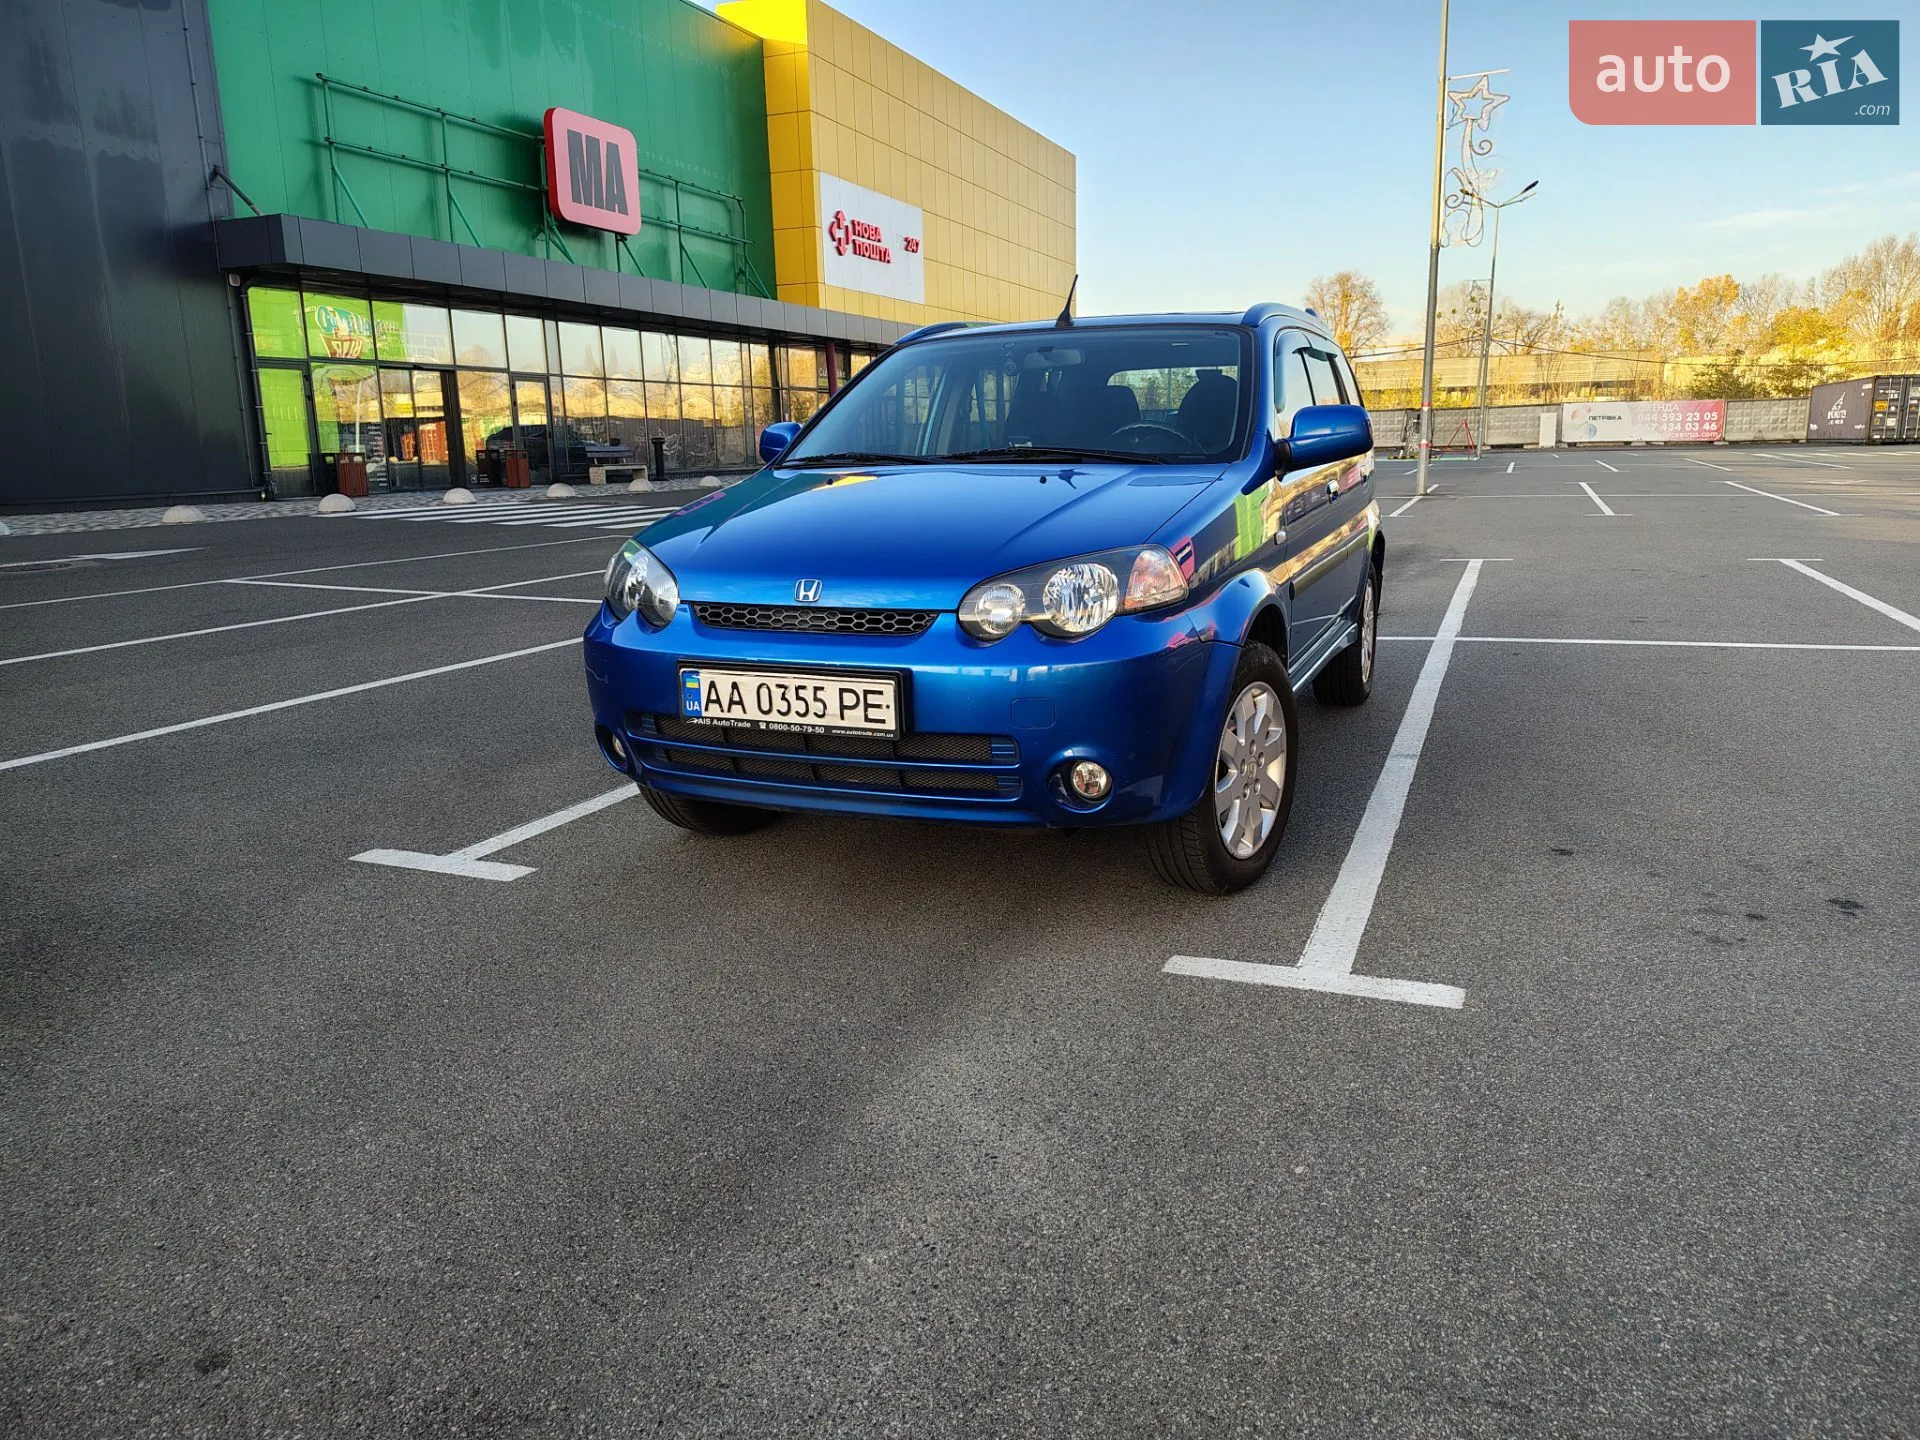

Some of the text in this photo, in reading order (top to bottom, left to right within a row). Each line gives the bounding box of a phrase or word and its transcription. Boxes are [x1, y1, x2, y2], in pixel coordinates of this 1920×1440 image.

[567, 129, 629, 216] MA
[851, 219, 882, 243] НОВА
[852, 239, 892, 264] ПОШТА
[1685, 422, 1700, 431] 03
[1703, 421, 1717, 431] 46
[1686, 412, 1700, 421] 23
[1703, 411, 1718, 421] 05
[686, 701, 700, 711] UA
[704, 680, 887, 724] AA 0355 PE
[712, 718, 751, 728] AutoTrade
[769, 723, 825, 734] 0800-50-79-50
